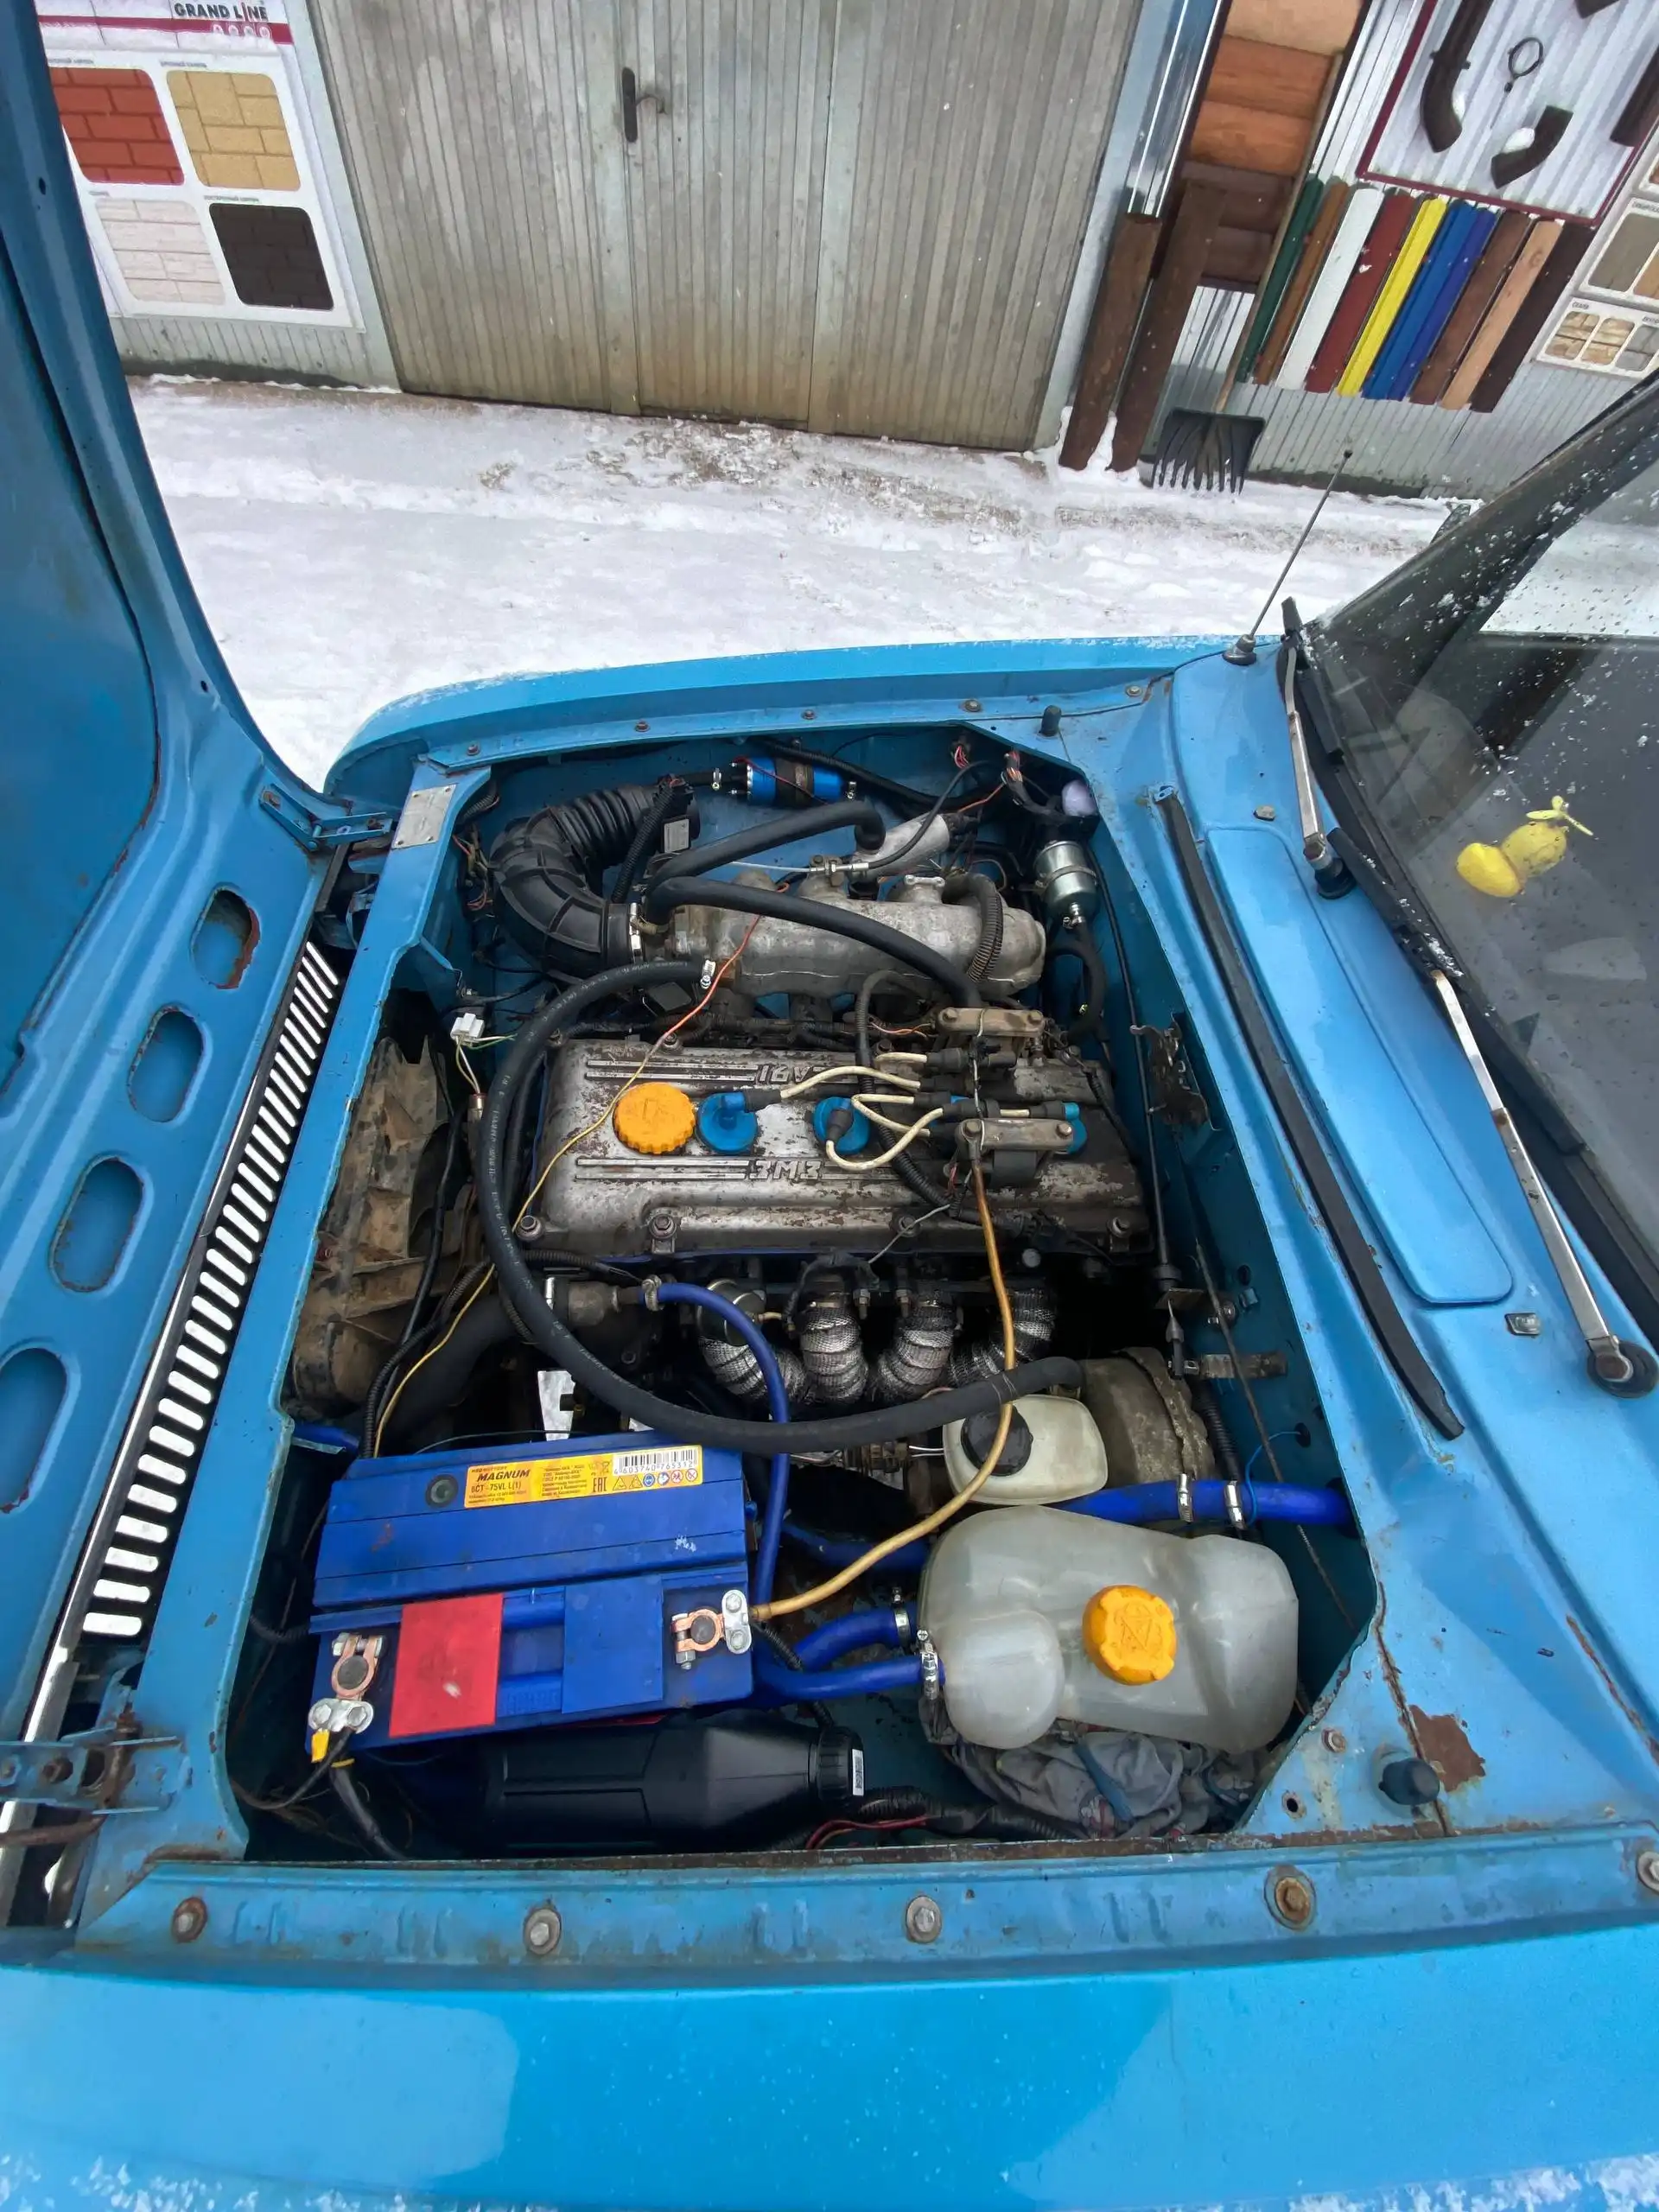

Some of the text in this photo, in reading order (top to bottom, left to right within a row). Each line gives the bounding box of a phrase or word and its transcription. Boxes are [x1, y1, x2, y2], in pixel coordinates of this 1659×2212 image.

[174, 2, 269, 22] GRAND LINE
[476, 1468, 531, 1482] MAGNUM
